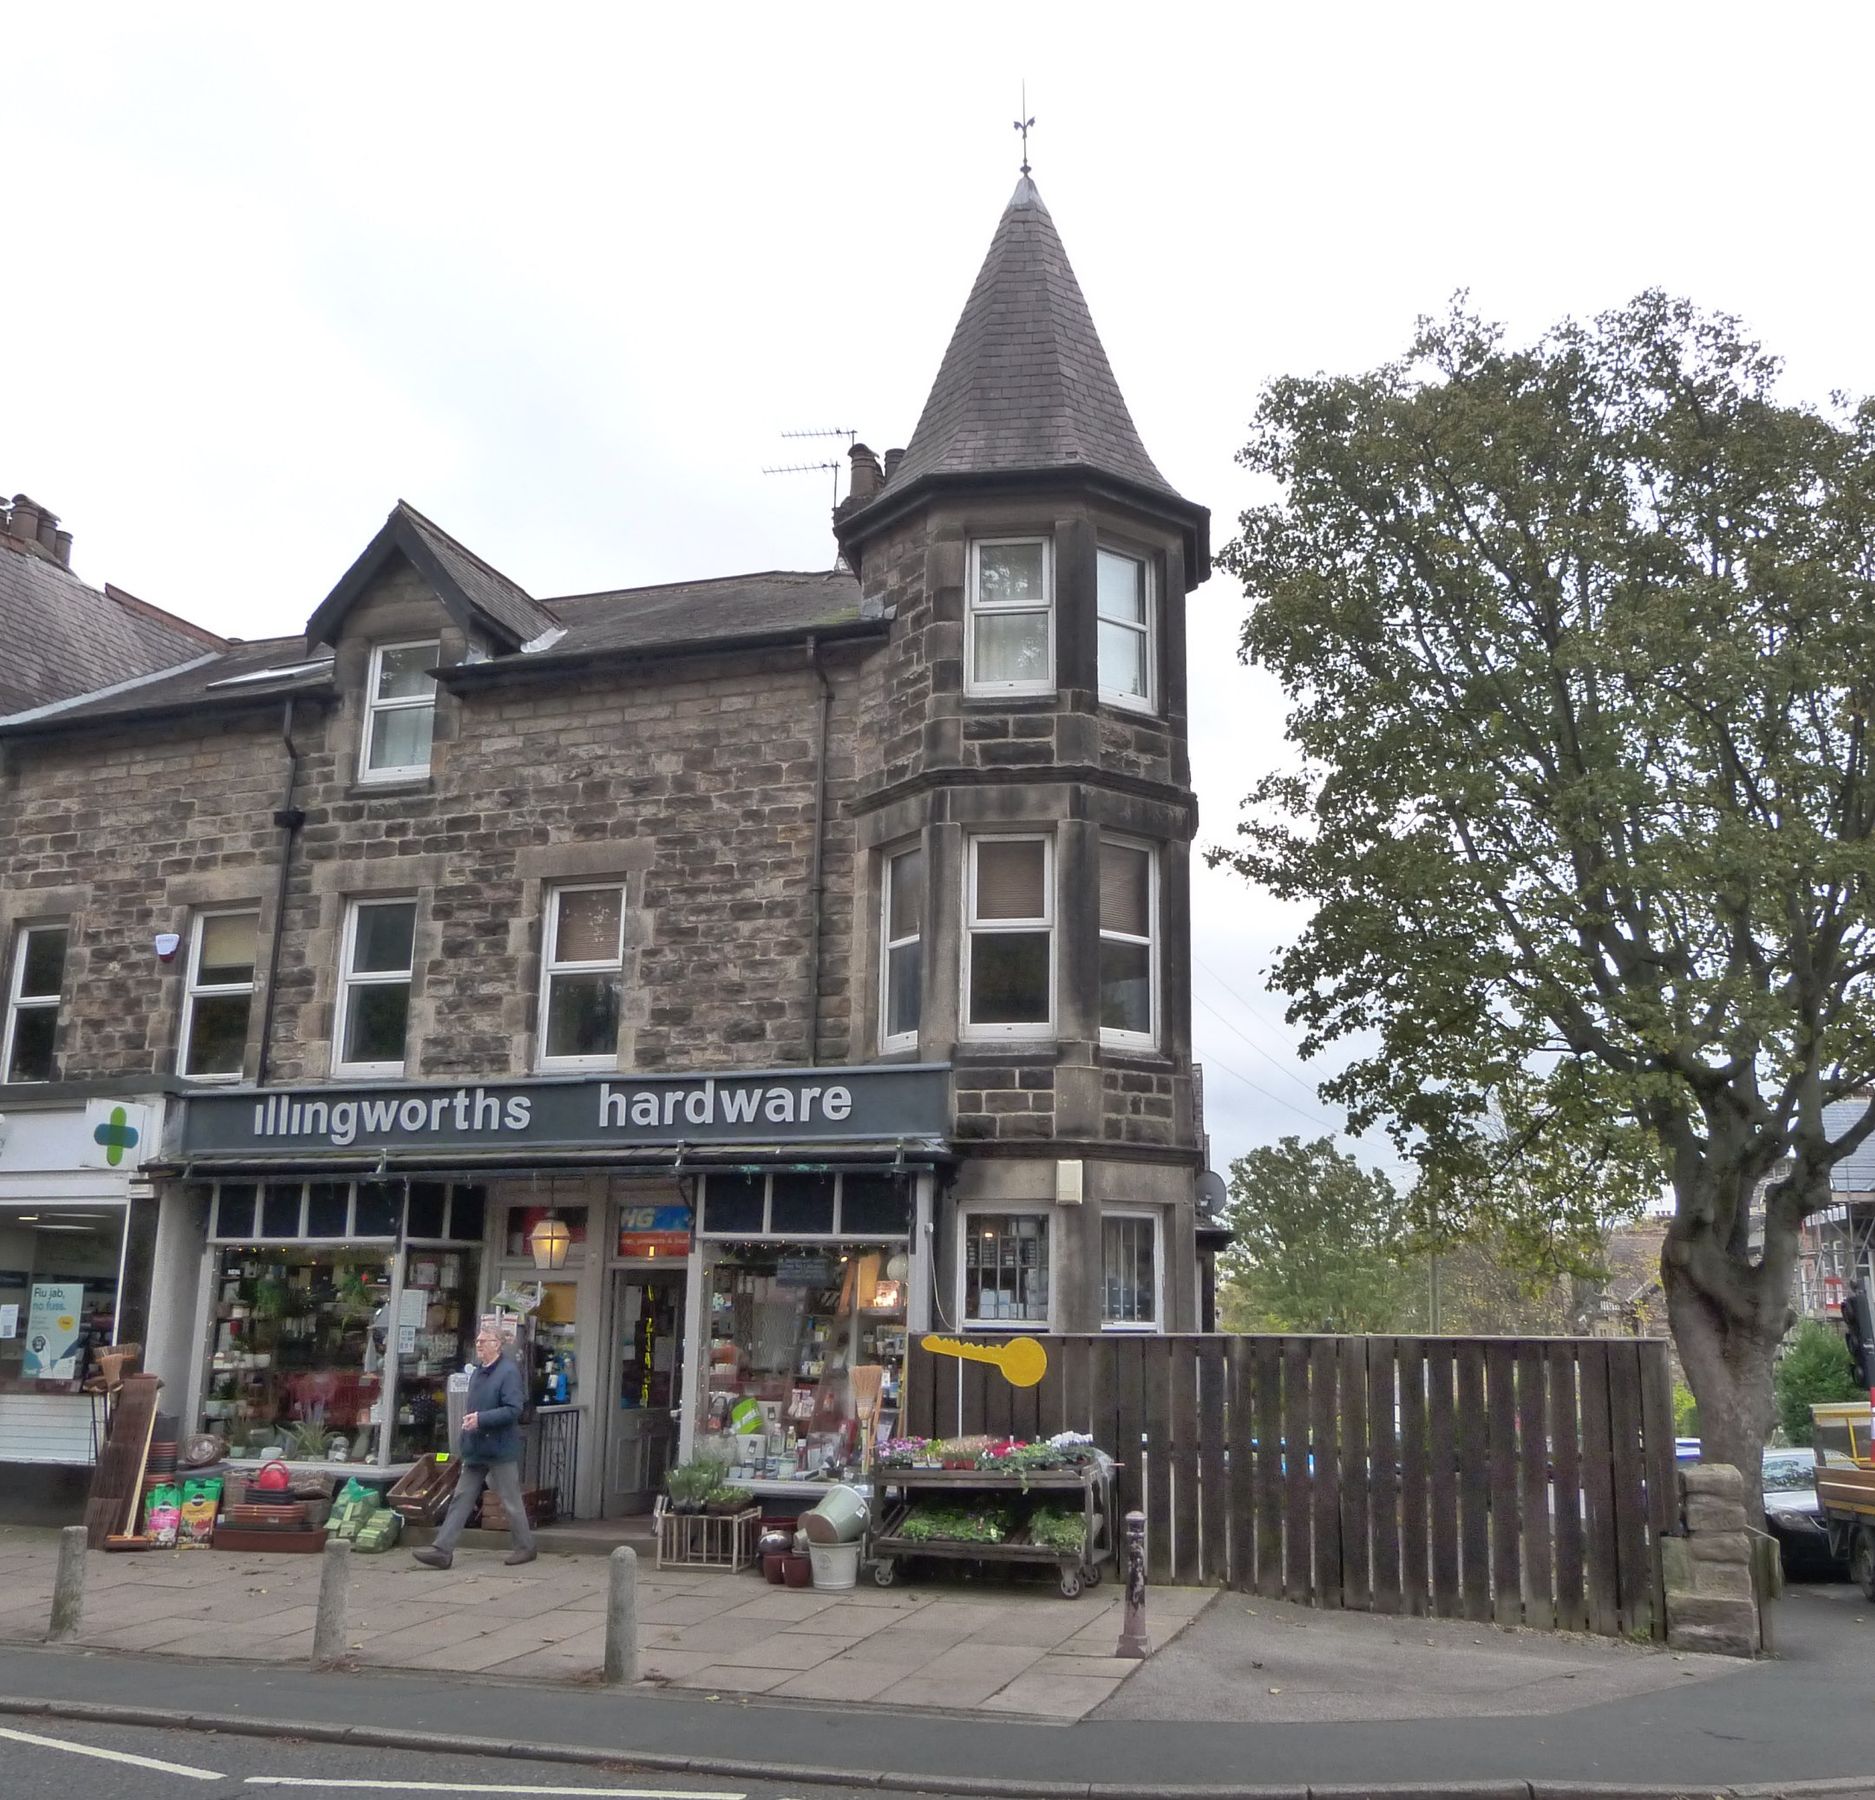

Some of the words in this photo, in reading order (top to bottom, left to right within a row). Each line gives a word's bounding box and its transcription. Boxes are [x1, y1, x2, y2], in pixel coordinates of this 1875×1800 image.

[254, 1087, 531, 1145] illingworths
[598, 1079, 852, 1127] hardware
[34, 1287, 47, 1298] Flu
